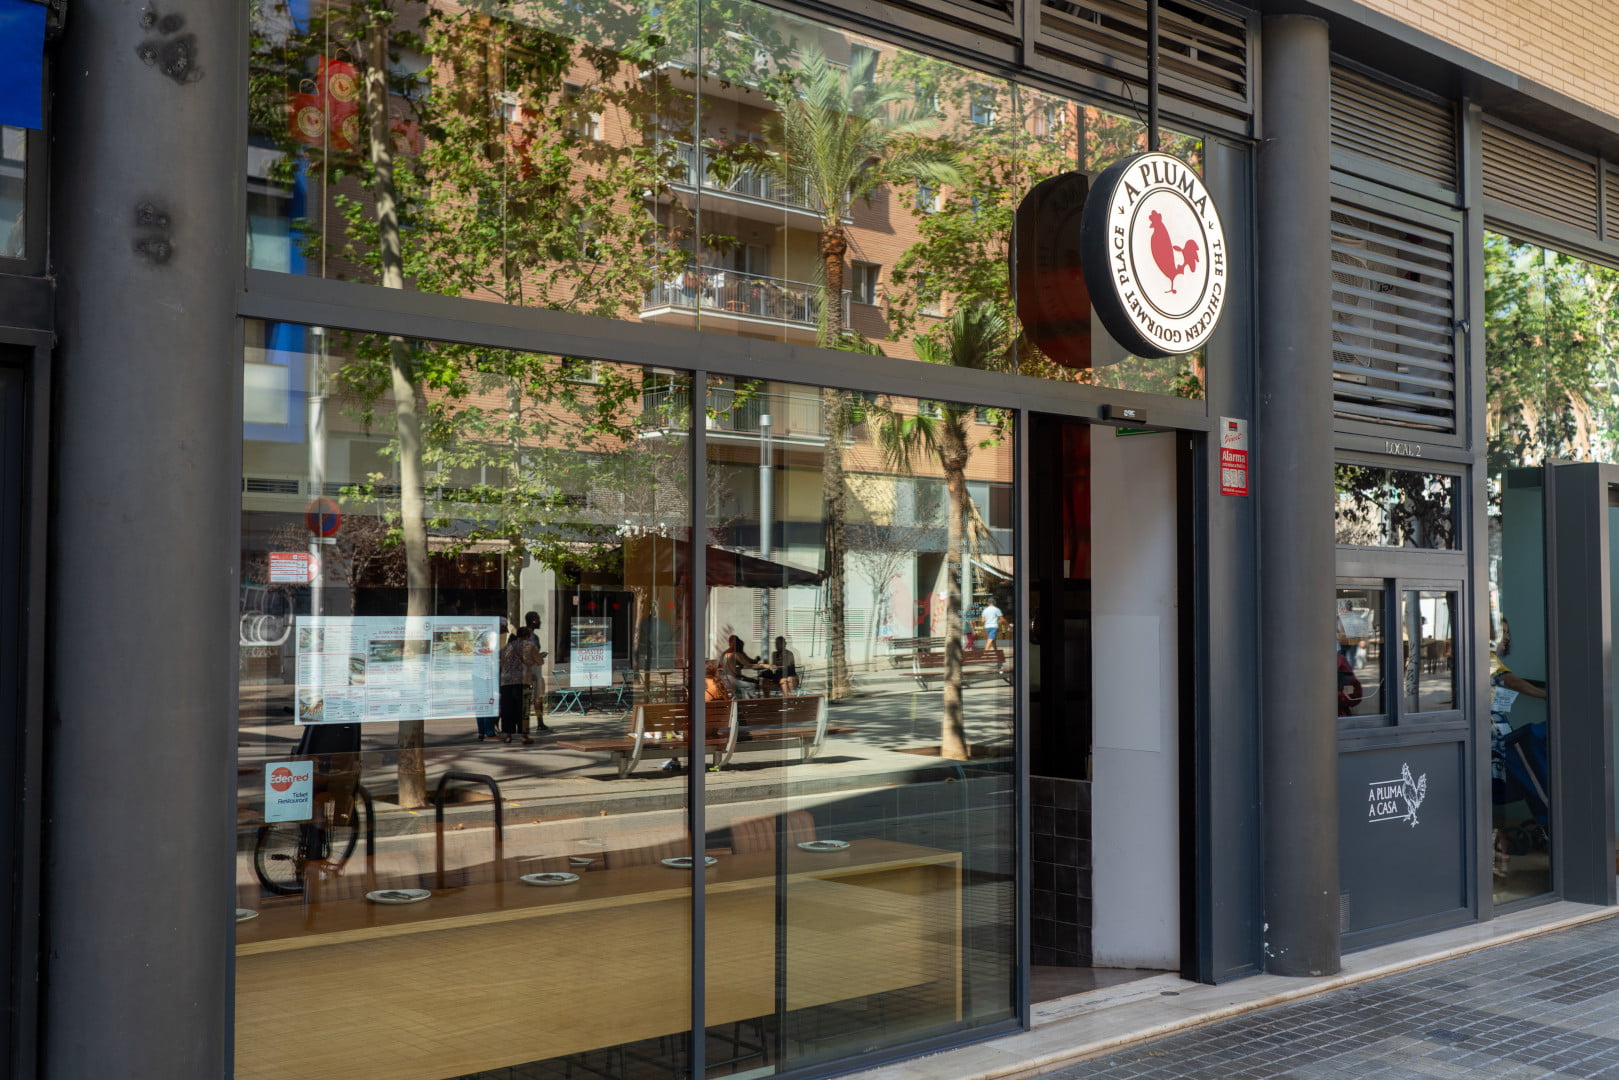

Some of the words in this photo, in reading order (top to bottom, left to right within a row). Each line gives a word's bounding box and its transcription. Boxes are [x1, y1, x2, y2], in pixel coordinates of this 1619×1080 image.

[1124, 180, 1141, 206] A
[1139, 160, 1208, 218] PLUMA
[1114, 225, 1131, 286] PLACE
[1212, 239, 1223, 277] THE
[1124, 290, 1182, 343] GOURMET
[1185, 282, 1222, 343] CHICKEN
[1222, 450, 1246, 463] Alarma
[1385, 441, 1414, 457] LOCAL
[1415, 444, 1421, 457] 2
[270, 772, 309, 784] Edenred
[1368, 788, 1376, 802] A
[1376, 785, 1403, 801] PLUMA
[1368, 803, 1376, 817] A
[1376, 800, 1398, 816] CASA
